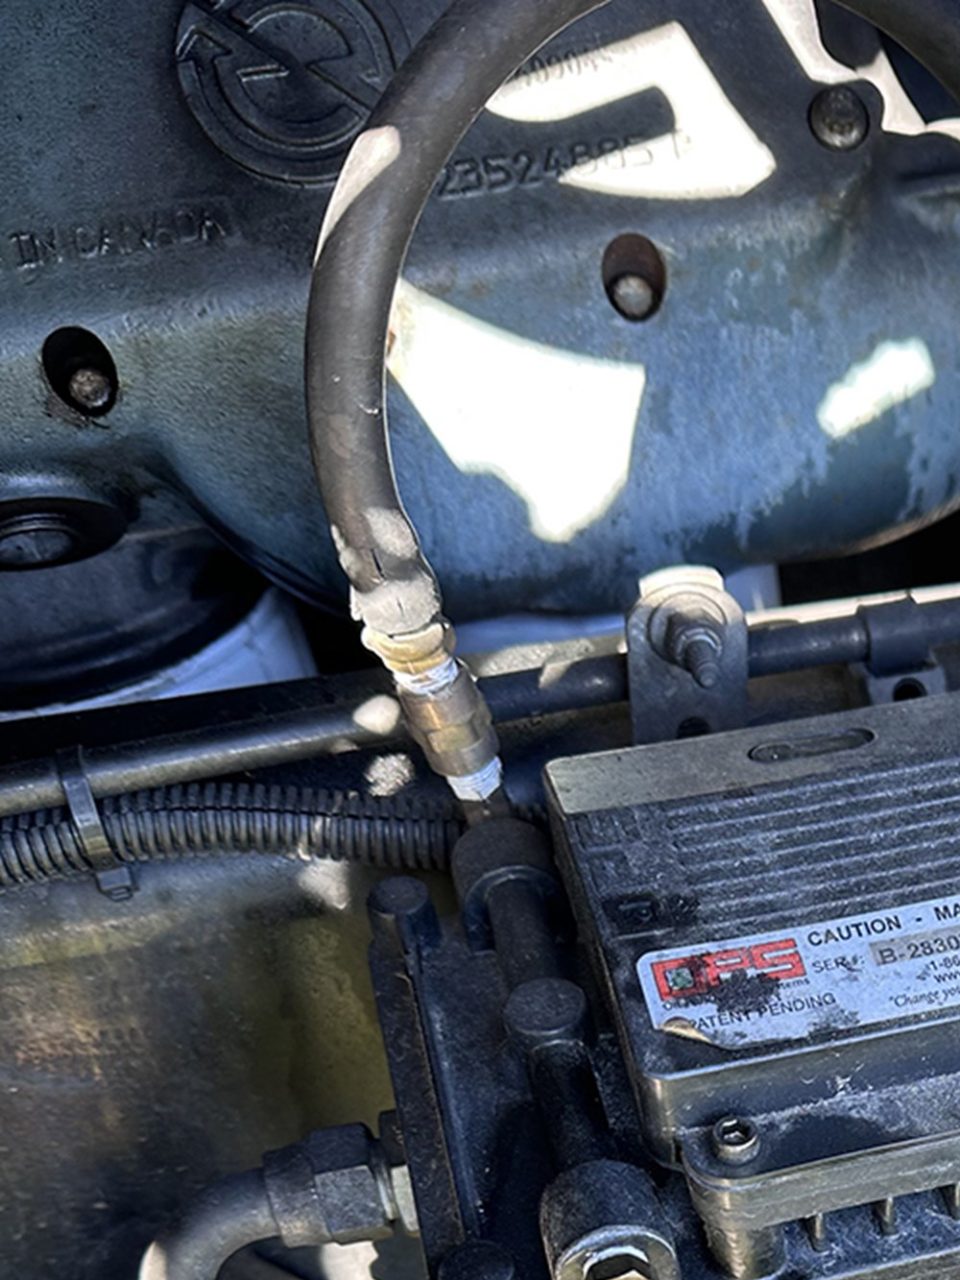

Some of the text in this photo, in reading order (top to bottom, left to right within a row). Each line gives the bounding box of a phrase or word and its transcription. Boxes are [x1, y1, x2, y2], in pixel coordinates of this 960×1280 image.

[807, 915, 902, 946] CAUTION
[651, 937, 807, 1002] OPS
[757, 992, 836, 1021] PENDING
[889, 990, 941, 1007] "Change
